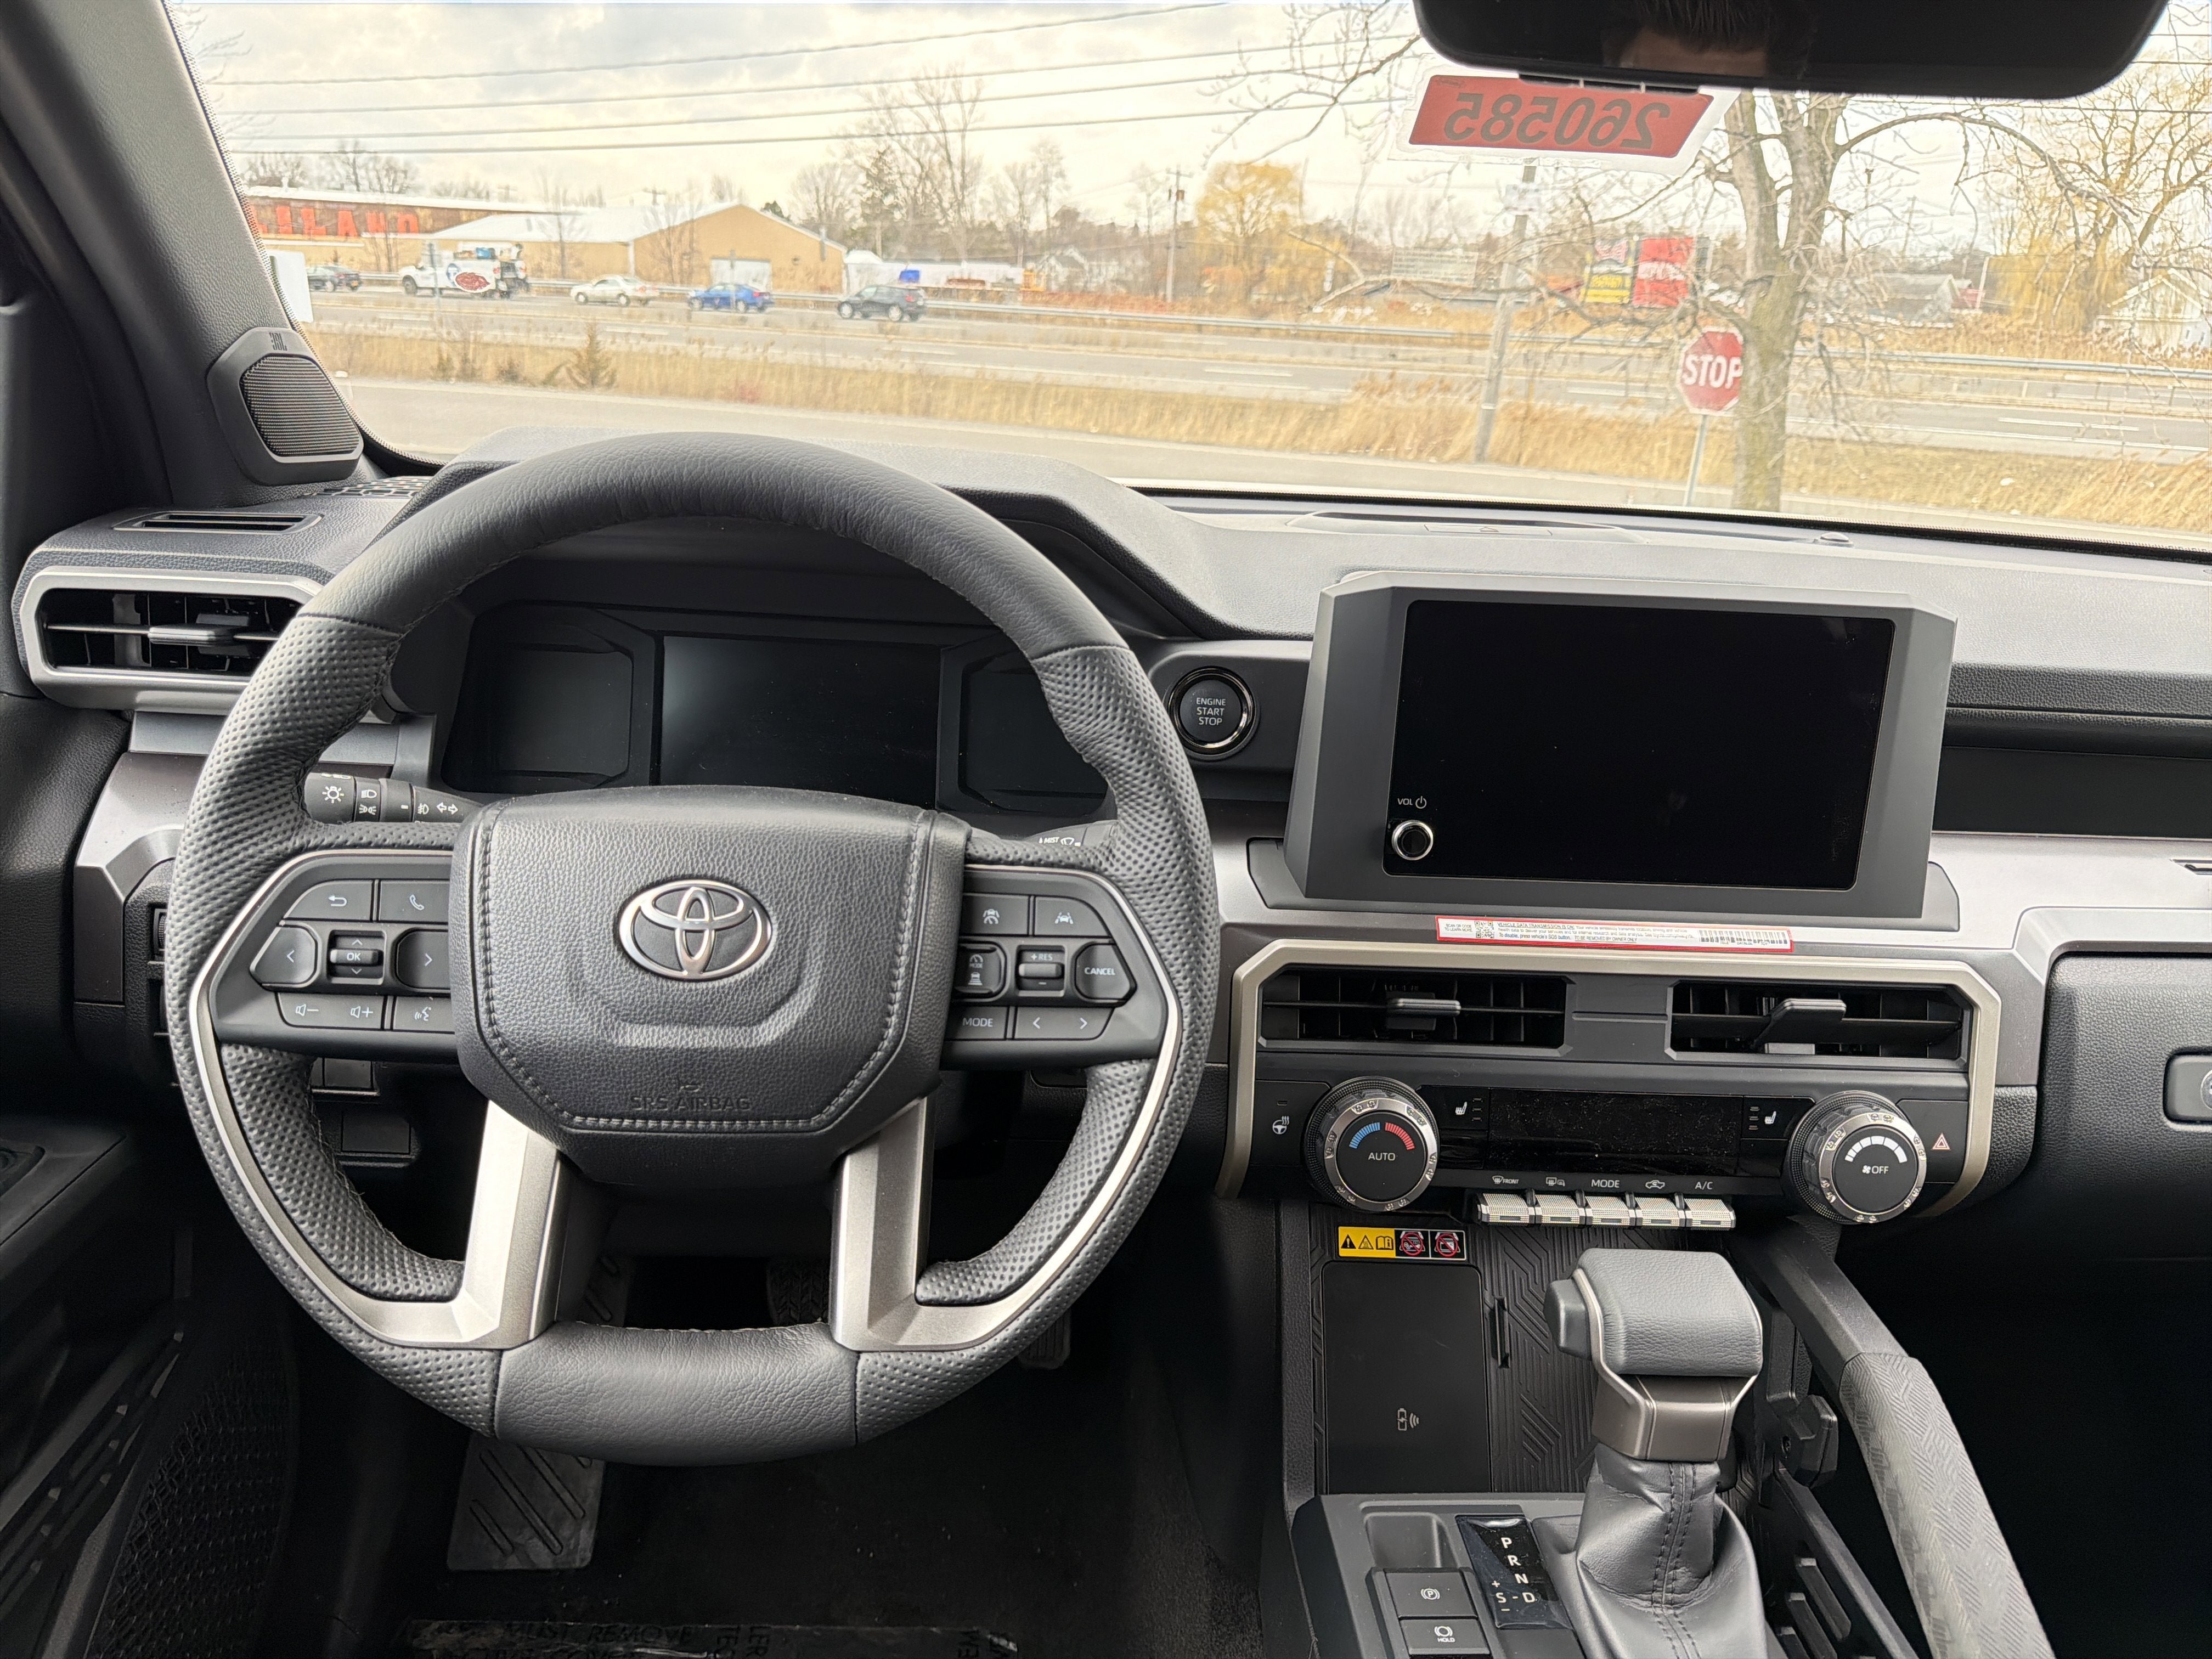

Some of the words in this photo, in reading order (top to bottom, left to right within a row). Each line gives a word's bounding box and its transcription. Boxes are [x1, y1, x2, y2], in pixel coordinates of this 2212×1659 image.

[1681, 353, 1743, 389] STOP
[1196, 697, 1226, 706] ENGINE
[1197, 707, 1225, 715] START
[1198, 716, 1222, 726] STOP
[1397, 798, 1413, 806] VOL
[347, 952, 361, 961] OK
[1084, 967, 1116, 975] CANCEL
[962, 1017, 994, 1028] MODE
[630, 1095, 669, 1111] SRS
[675, 1096, 751, 1111] AIRBAG
[1368, 1152, 1396, 1161] AUTO
[1871, 1165, 1889, 1174] OFF
[1591, 1179, 1620, 1189] MODE
[1694, 1181, 1713, 1190] A/C
[1500, 1537, 1513, 1549] P
[1507, 1555, 1521, 1566] R
[1514, 1573, 1529, 1584] N
